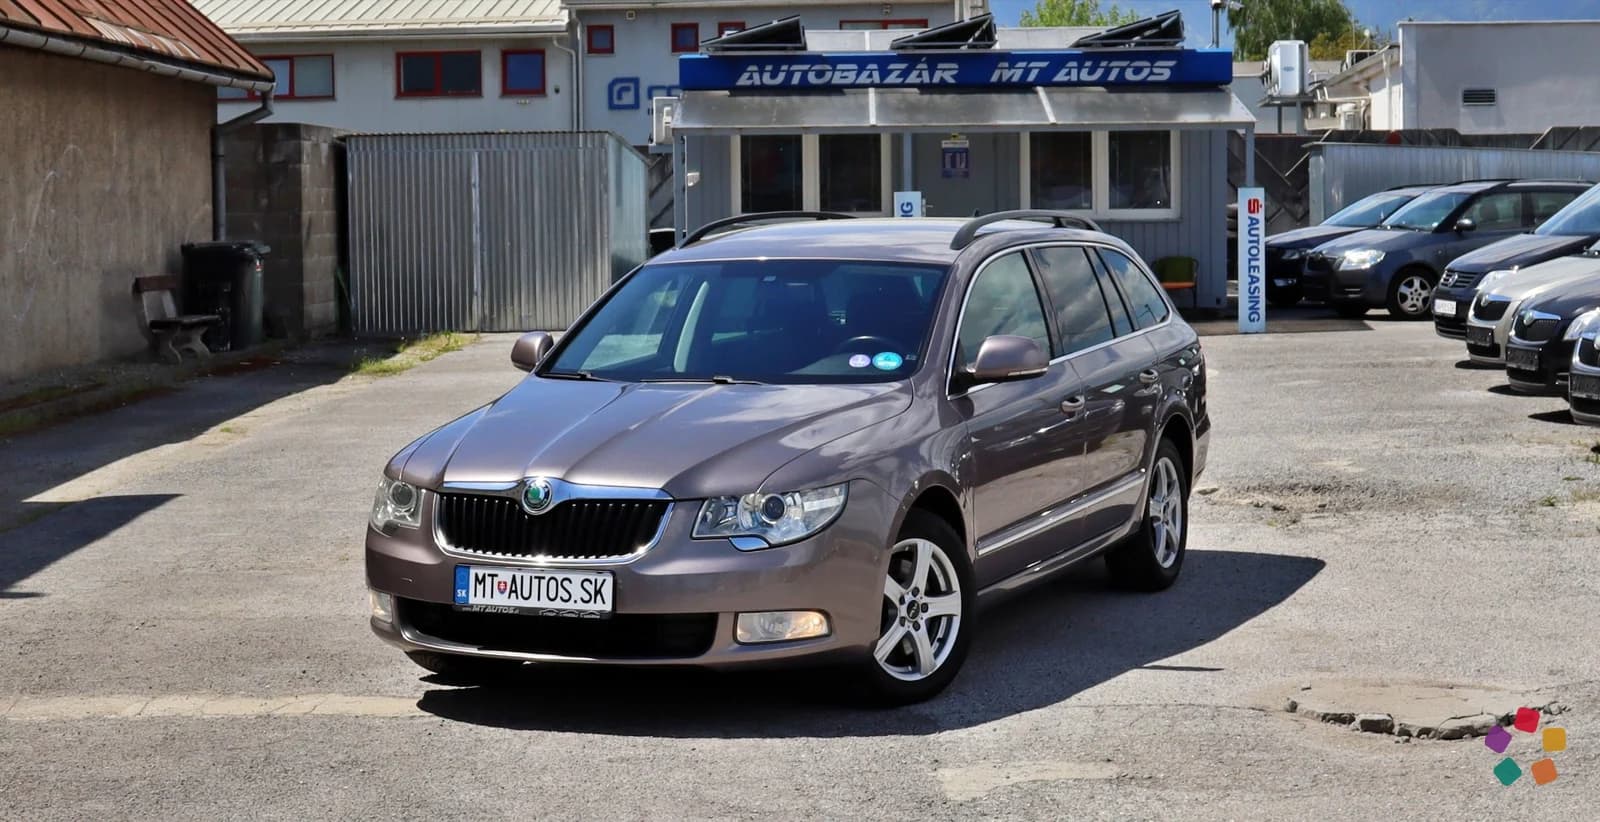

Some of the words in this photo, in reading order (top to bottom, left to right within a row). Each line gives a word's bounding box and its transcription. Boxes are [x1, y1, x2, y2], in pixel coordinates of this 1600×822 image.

[736, 57, 959, 86] AUTOBAZÁR
[990, 61, 1050, 82] MT
[1053, 60, 1177, 82] AUTOS
[1247, 216, 1260, 323] AUTOLEASING
[474, 572, 498, 599] MT
[507, 574, 607, 604] AUTOS.SK
